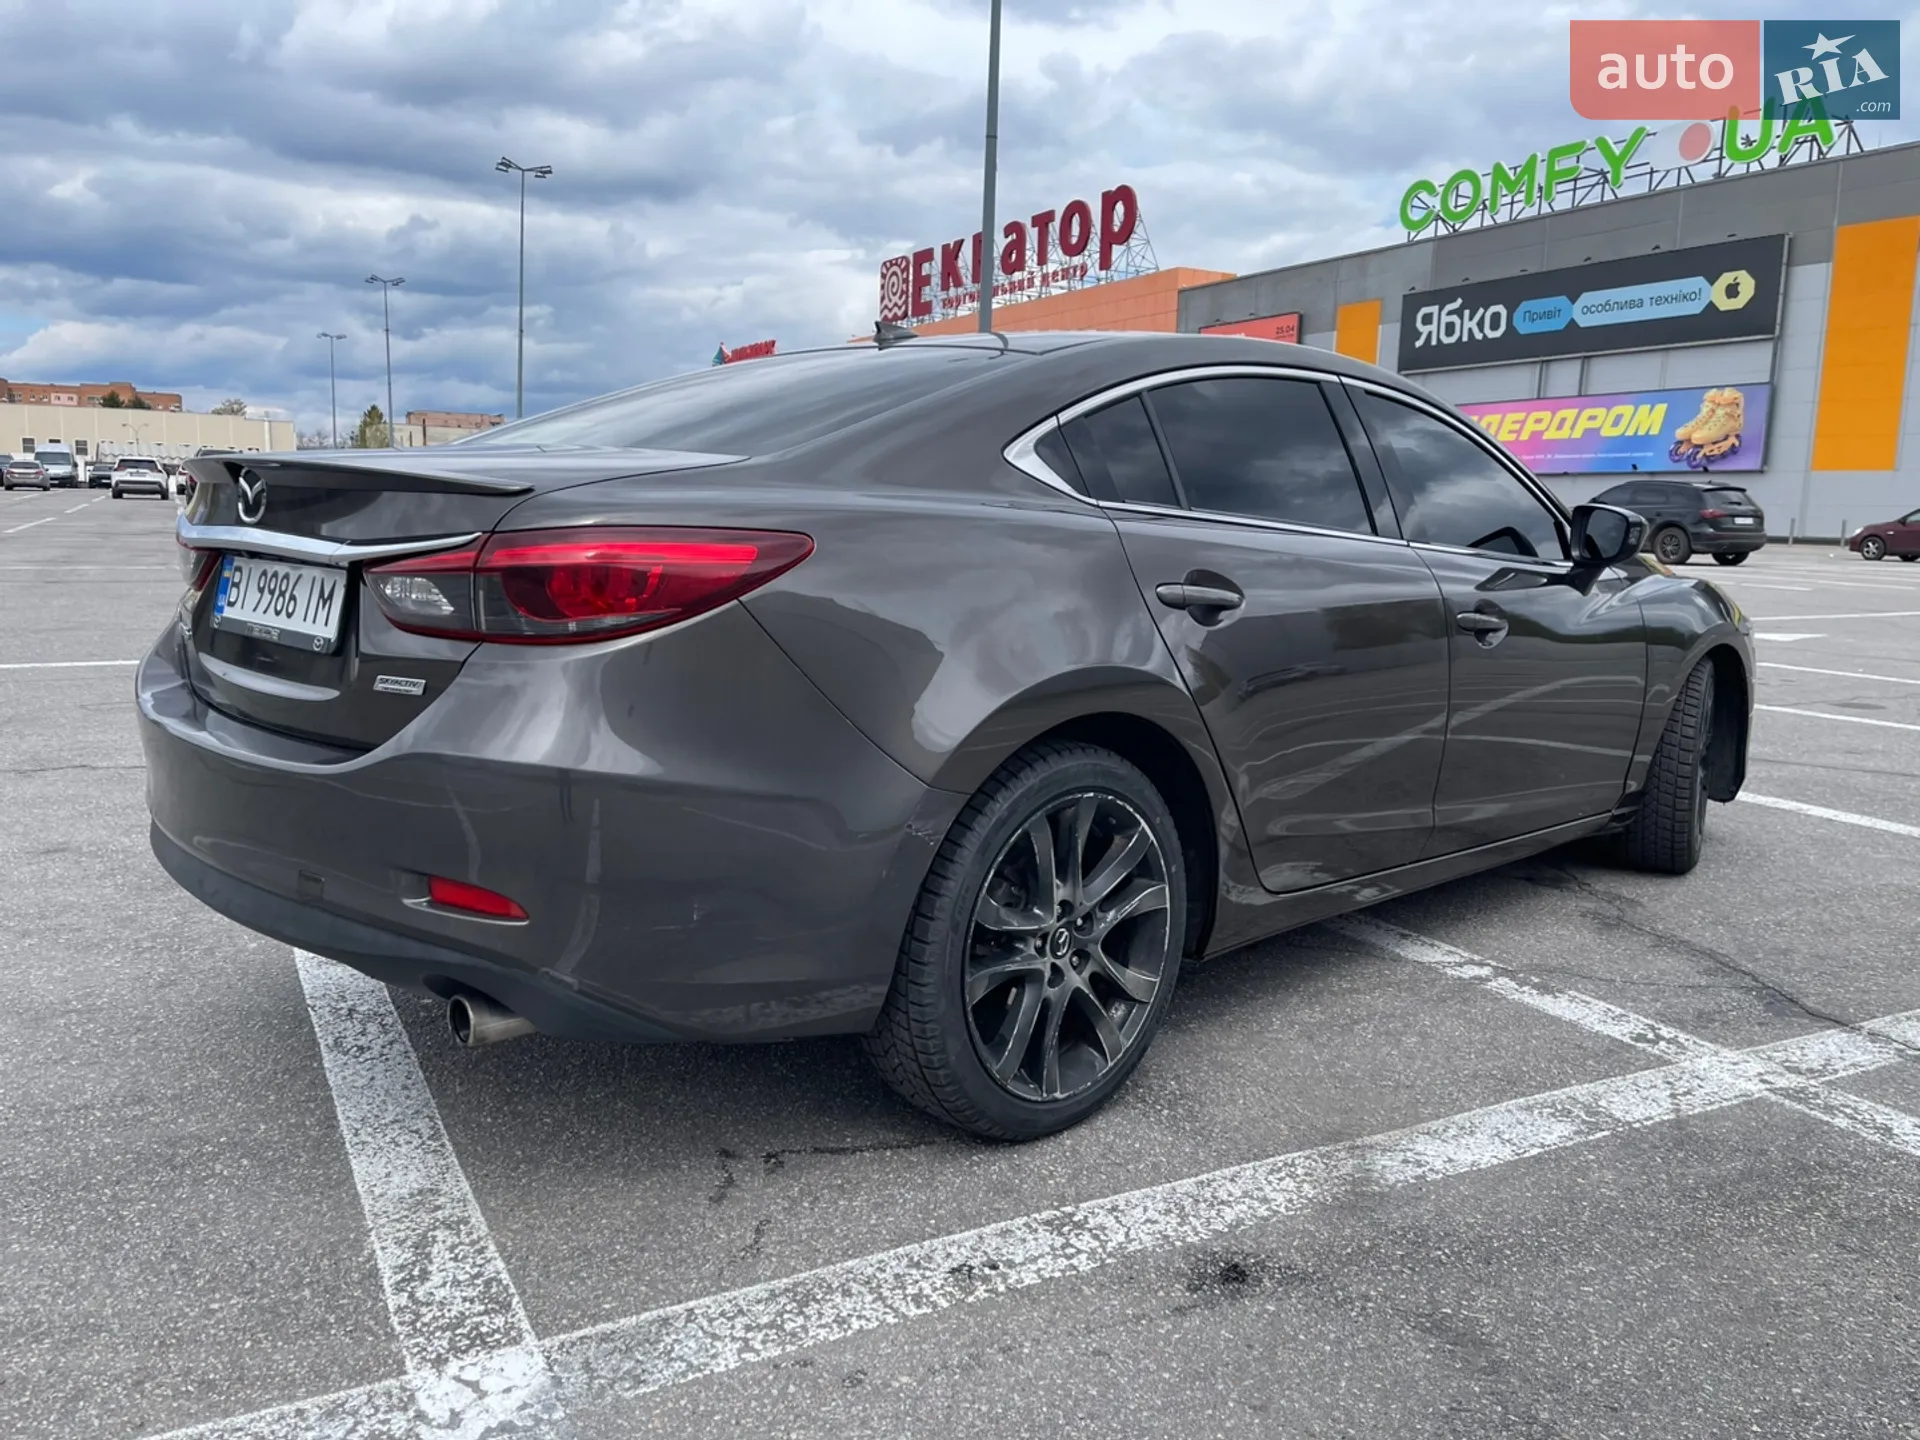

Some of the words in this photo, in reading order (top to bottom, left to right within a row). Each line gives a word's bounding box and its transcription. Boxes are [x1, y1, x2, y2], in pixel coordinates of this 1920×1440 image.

[1399, 125, 1650, 231] COMFY
[1414, 297, 1508, 348] Ябко
[1522, 306, 1562, 324] Привіт
[1581, 298, 1644, 316] особлива
[1648, 288, 1702, 307] техніко!
[227, 564, 253, 610] BI
[252, 568, 303, 619] 9986
[303, 575, 337, 627] IM
